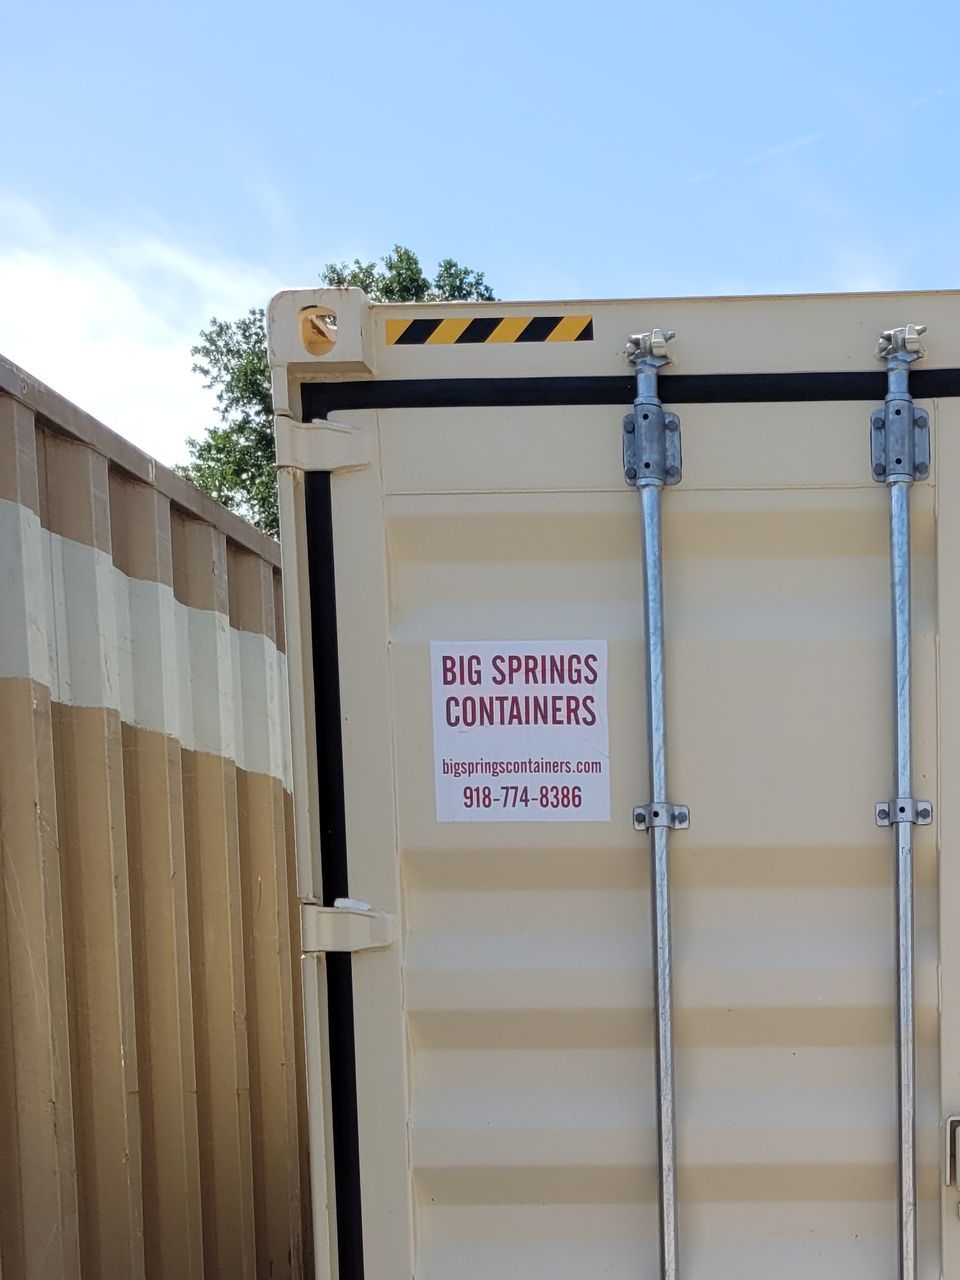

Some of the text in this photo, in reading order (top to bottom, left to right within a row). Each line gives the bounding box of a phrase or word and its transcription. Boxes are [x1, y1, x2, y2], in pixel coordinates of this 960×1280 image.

[443, 654, 597, 685] BIG SPRINGS
[446, 696, 596, 727] CONTAINERS
[443, 758, 601, 777] bigspringscontainers.com
[464, 786, 581, 808] 918-774-8386
